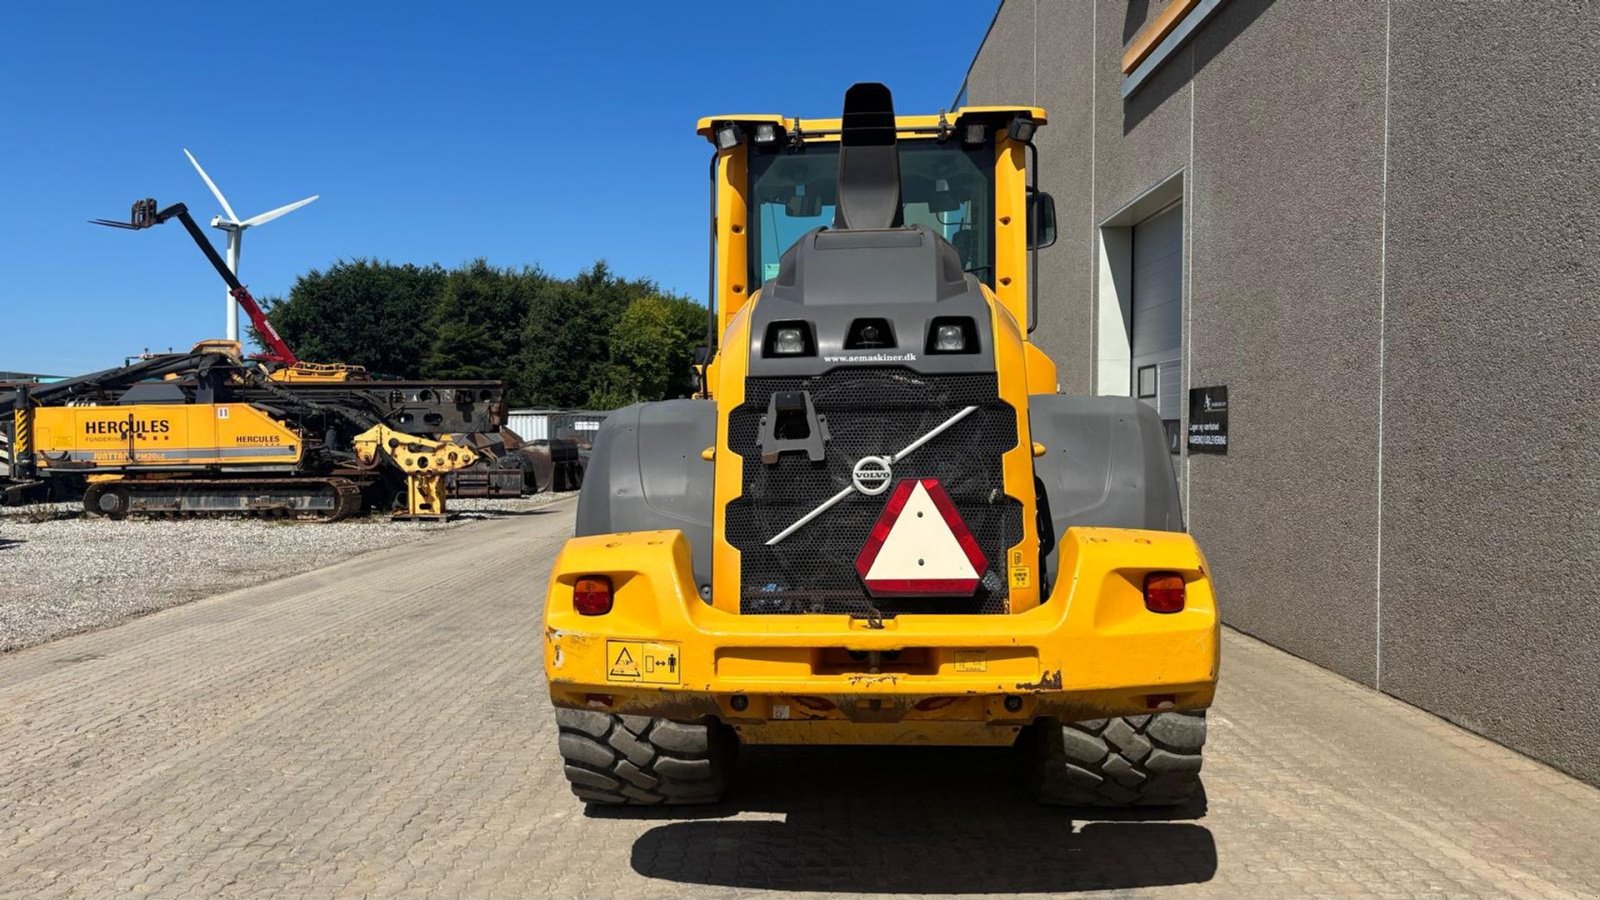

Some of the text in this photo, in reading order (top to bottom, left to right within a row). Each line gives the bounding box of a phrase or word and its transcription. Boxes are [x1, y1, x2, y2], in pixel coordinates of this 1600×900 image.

[824, 353, 917, 362] www.aemaskiner.dk
[85, 420, 169, 434] HERCULES
[236, 435, 280, 443] HERCULES
